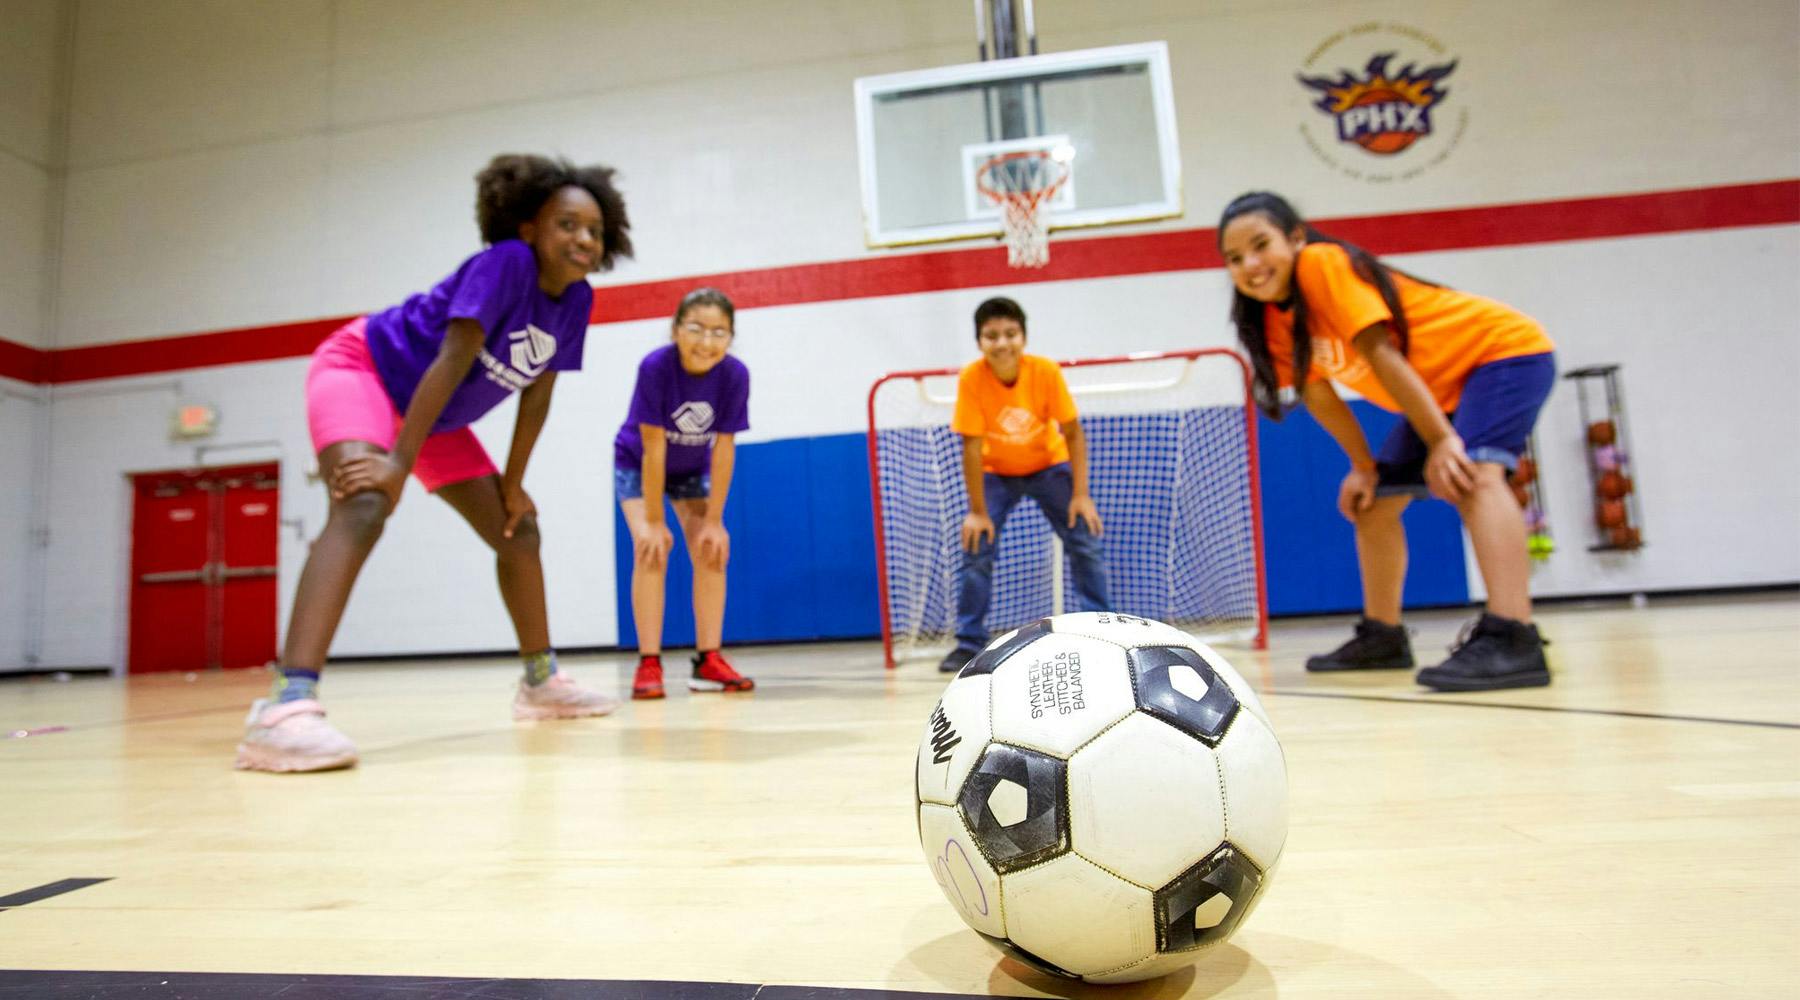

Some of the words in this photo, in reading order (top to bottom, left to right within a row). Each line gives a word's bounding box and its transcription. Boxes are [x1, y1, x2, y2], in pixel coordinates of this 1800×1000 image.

[1343, 102, 1426, 138] PHX
[1055, 652, 1066, 660] &
[1042, 661, 1055, 708] LEATHER
[1056, 662, 1071, 715] STITCHED
[1069, 652, 1085, 710] BALANCED
